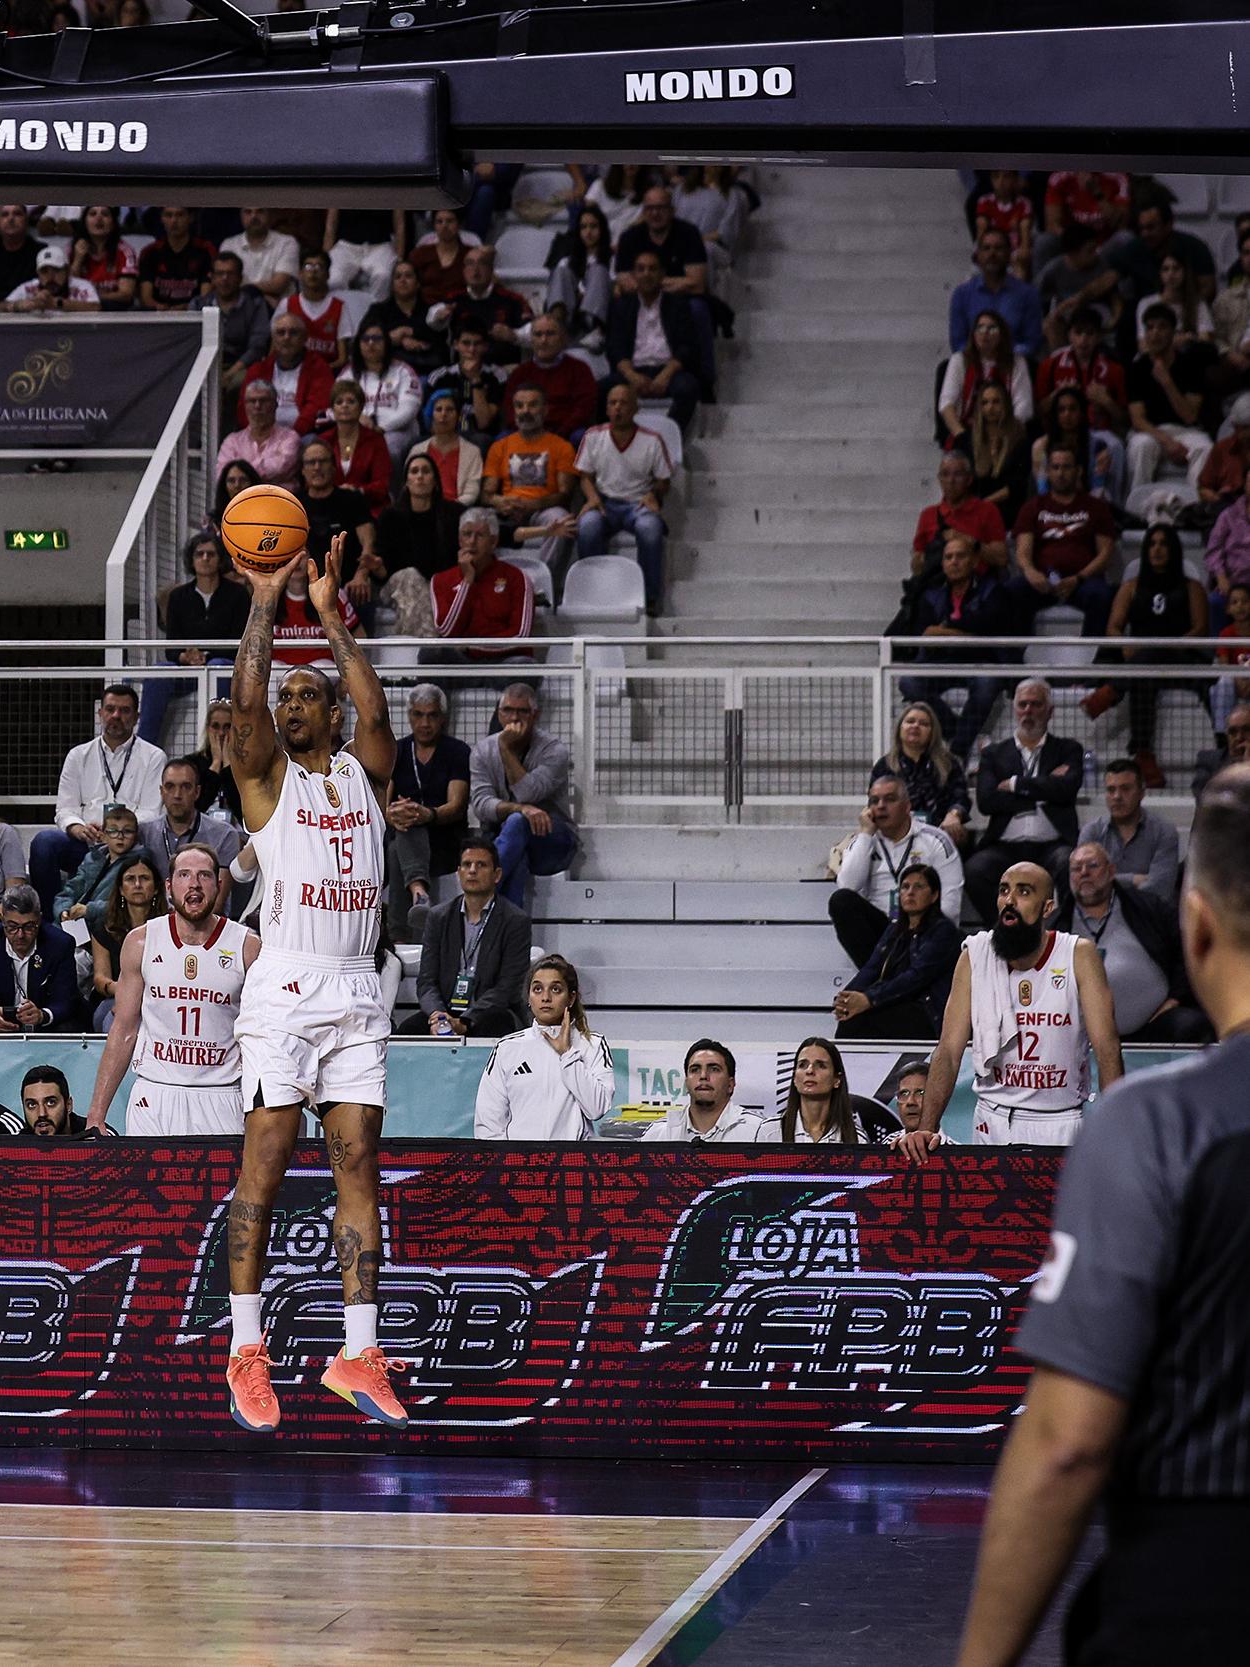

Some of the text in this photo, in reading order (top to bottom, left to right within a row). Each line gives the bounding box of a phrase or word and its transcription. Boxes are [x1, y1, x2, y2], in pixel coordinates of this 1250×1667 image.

[626, 66, 793, 103] MONDO
[28, 407, 108, 421] FILIGRANA
[273, 624, 325, 636] Emirate
[329, 836, 354, 875] 15
[300, 882, 379, 913] RAMIREZ
[584, 888, 595, 900] D
[832, 976, 842, 988] C
[149, 985, 231, 1006] SL BENFICA
[176, 1005, 202, 1037] 11
[1015, 1012, 1072, 1027] ENFICA
[153, 1041, 227, 1066] RAMIREZ
[168, 1037, 218, 1049] conservas
[1016, 1030, 1040, 1062] 12
[728, 1216, 861, 1279] LOJA
